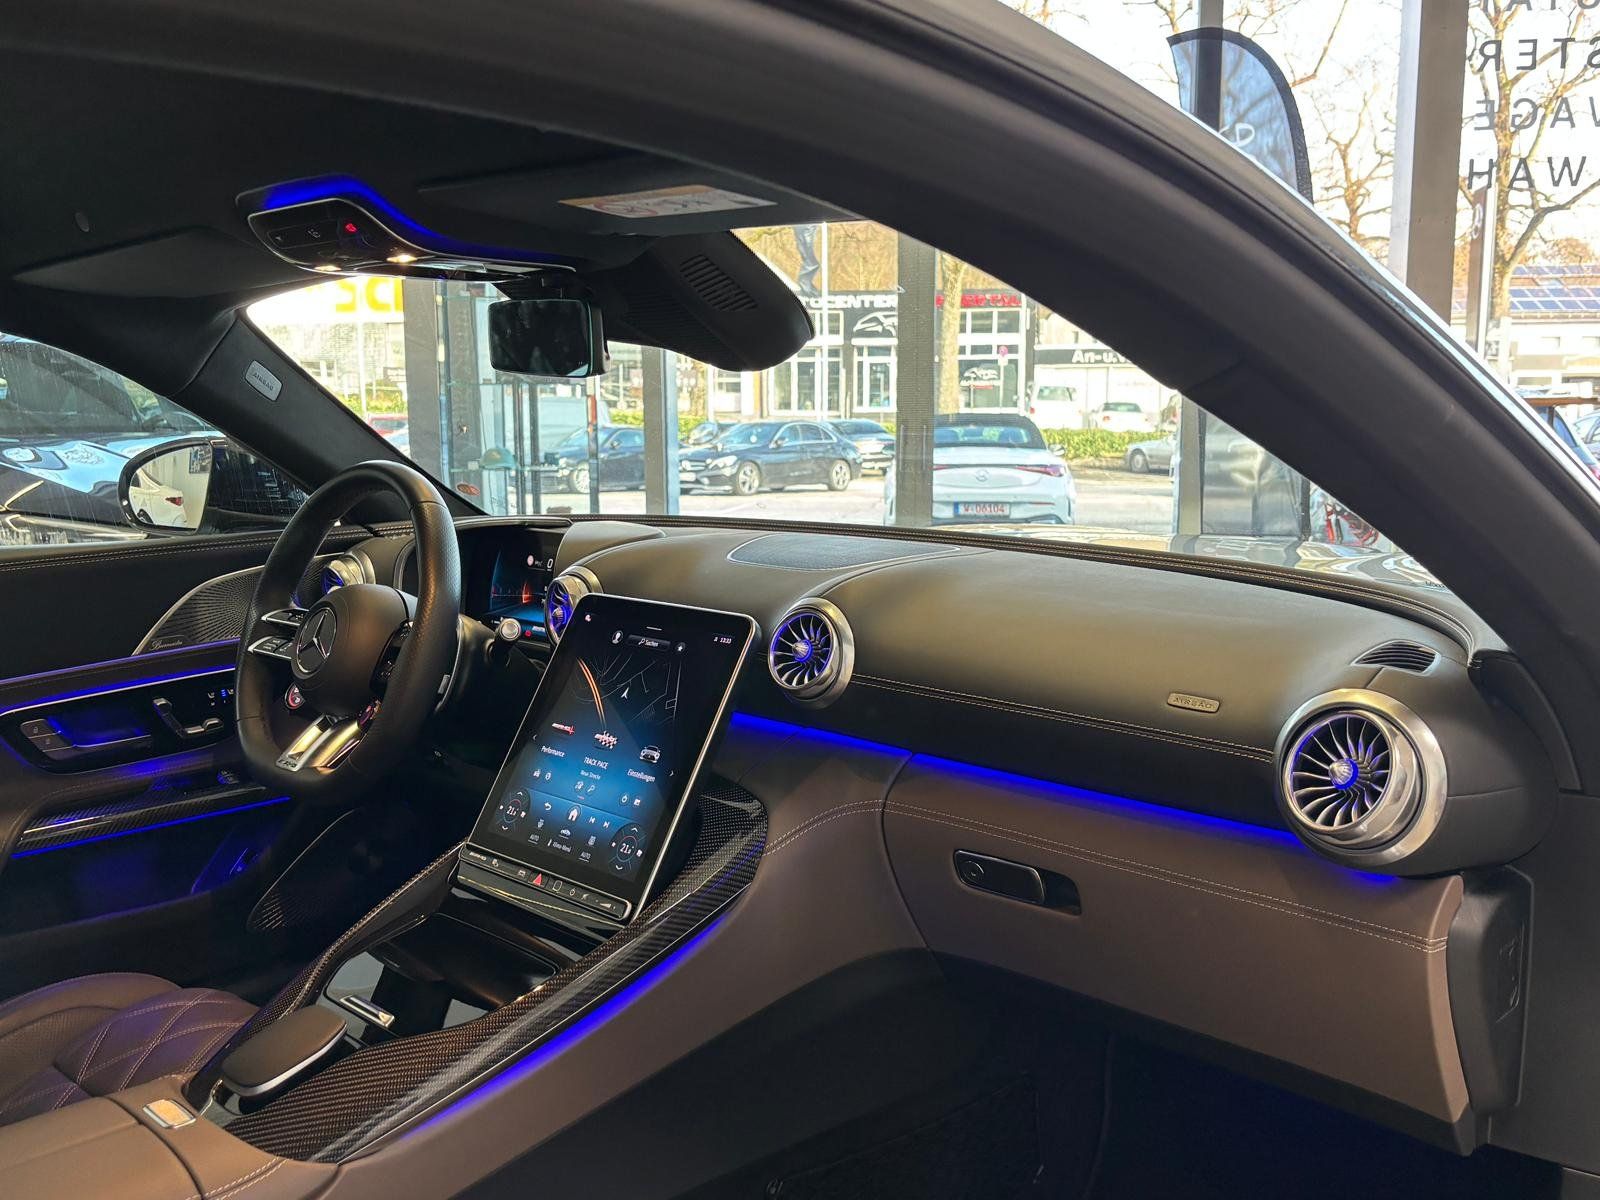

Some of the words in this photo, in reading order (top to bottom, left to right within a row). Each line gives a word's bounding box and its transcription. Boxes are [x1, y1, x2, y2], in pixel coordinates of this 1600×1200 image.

[540, 745, 566, 758] Performance
[583, 756, 598, 768] TRACK
[626, 768, 656, 783] Einstellungen
